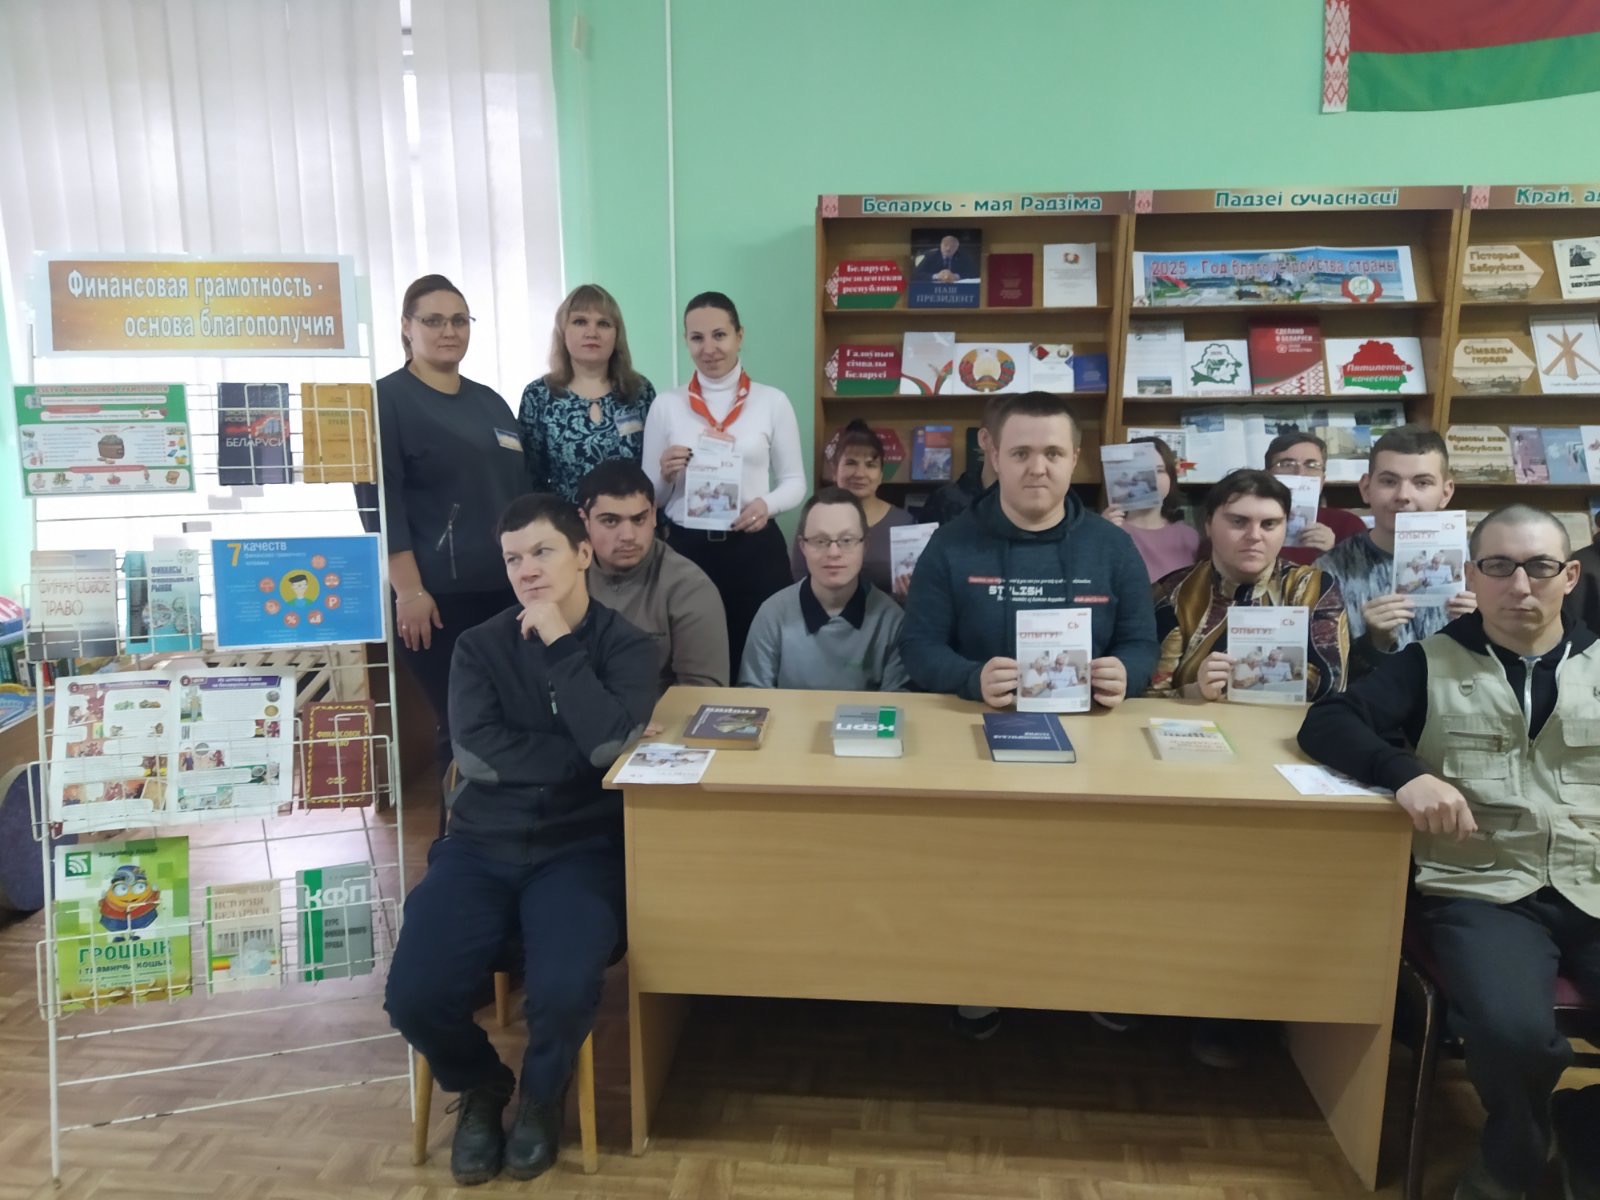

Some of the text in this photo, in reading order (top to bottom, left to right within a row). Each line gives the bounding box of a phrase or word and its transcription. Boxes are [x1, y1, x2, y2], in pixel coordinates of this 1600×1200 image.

[1215, 188, 1399, 208] Падзеі сучаснасці
[863, 196, 953, 214] Беларусь
[974, 199, 1013, 213] мая
[1021, 195, 1102, 212] Радзіма
[847, 264, 890, 274] Беларусь
[1151, 260, 1187, 276] 2025
[1201, 260, 1228, 274] Год
[1349, 259, 1398, 273] страны
[838, 275, 903, 283] президентская
[68, 269, 189, 299] Финансовая
[195, 275, 312, 304] грамотность
[842, 285, 898, 295] республика
[916, 295, 974, 304] ПРЕЗИДЕНТ
[124, 308, 335, 344] основа благополучия
[1463, 345, 1513, 355] Сімвалы
[1472, 356, 1508, 364] горада
[1346, 364, 1407, 373] Пятилетка
[845, 370, 887, 380] Беларусі
[226, 437, 285, 447] БЕЛАРУСИ
[227, 541, 287, 567] 7 качеств
